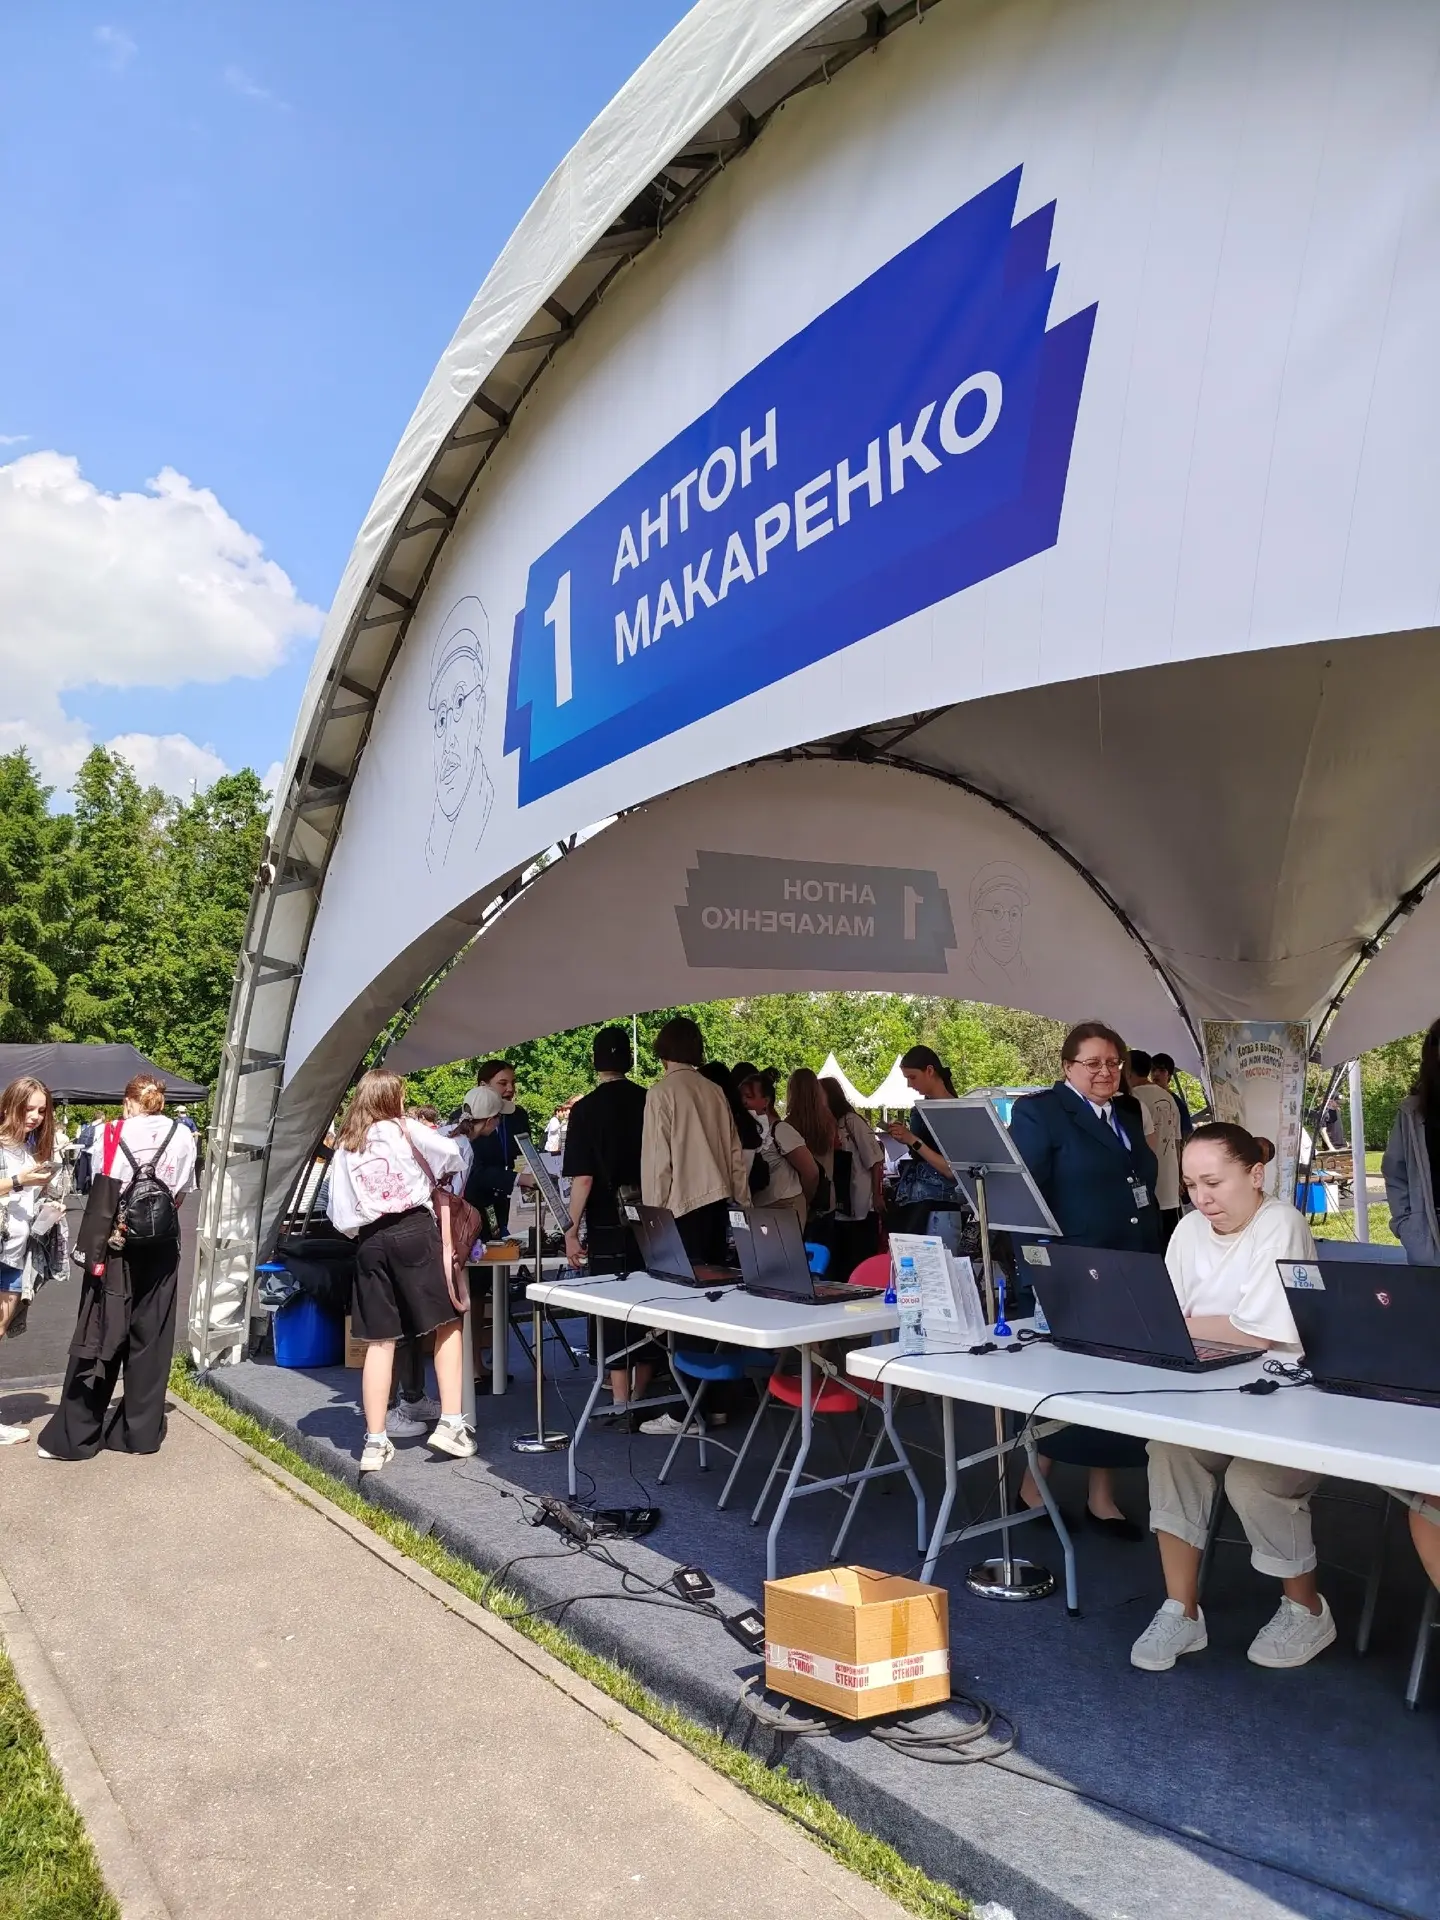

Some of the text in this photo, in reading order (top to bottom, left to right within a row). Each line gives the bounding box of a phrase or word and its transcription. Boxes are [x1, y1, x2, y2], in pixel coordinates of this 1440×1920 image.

[611, 407, 778, 586] АНТОН
[614, 370, 1003, 666] МАКАРЕНКО
[543, 570, 574, 707] 1
[835, 1672, 870, 1688] СТЕКЛО!!
[892, 1664, 924, 1681] СТЕКЛО!!
